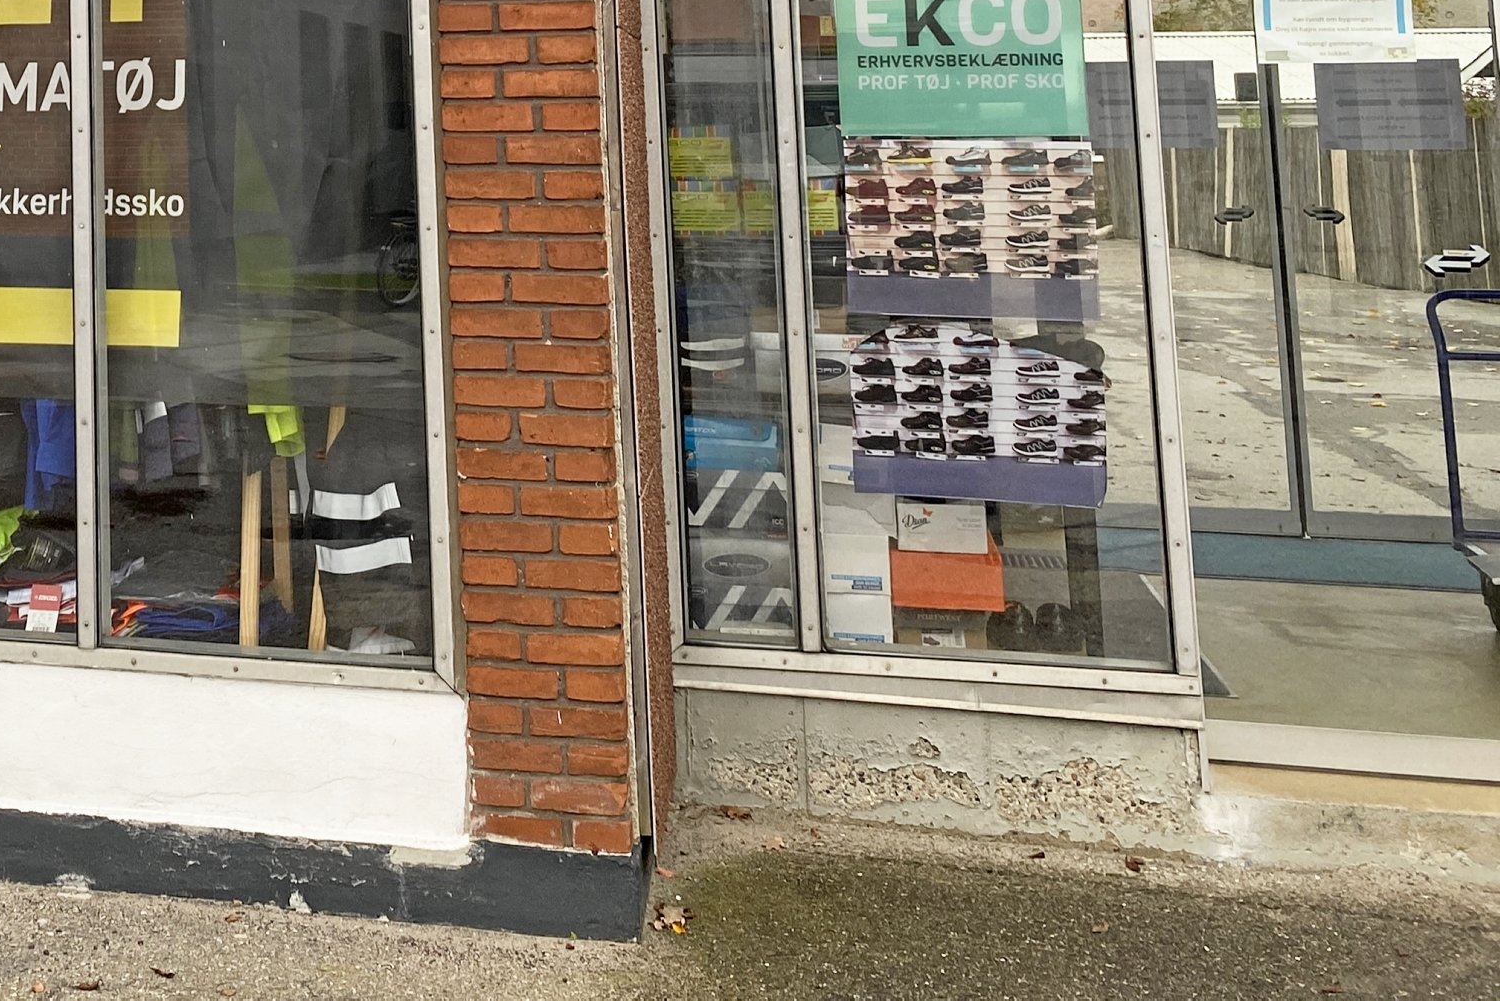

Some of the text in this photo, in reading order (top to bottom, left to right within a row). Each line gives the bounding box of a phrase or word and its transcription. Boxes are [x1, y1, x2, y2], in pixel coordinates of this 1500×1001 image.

[857, 53, 1064, 69] ERHVERVSBEKLÆDNING
[858, 72, 1064, 90] PROF TØJ PROF SKO
